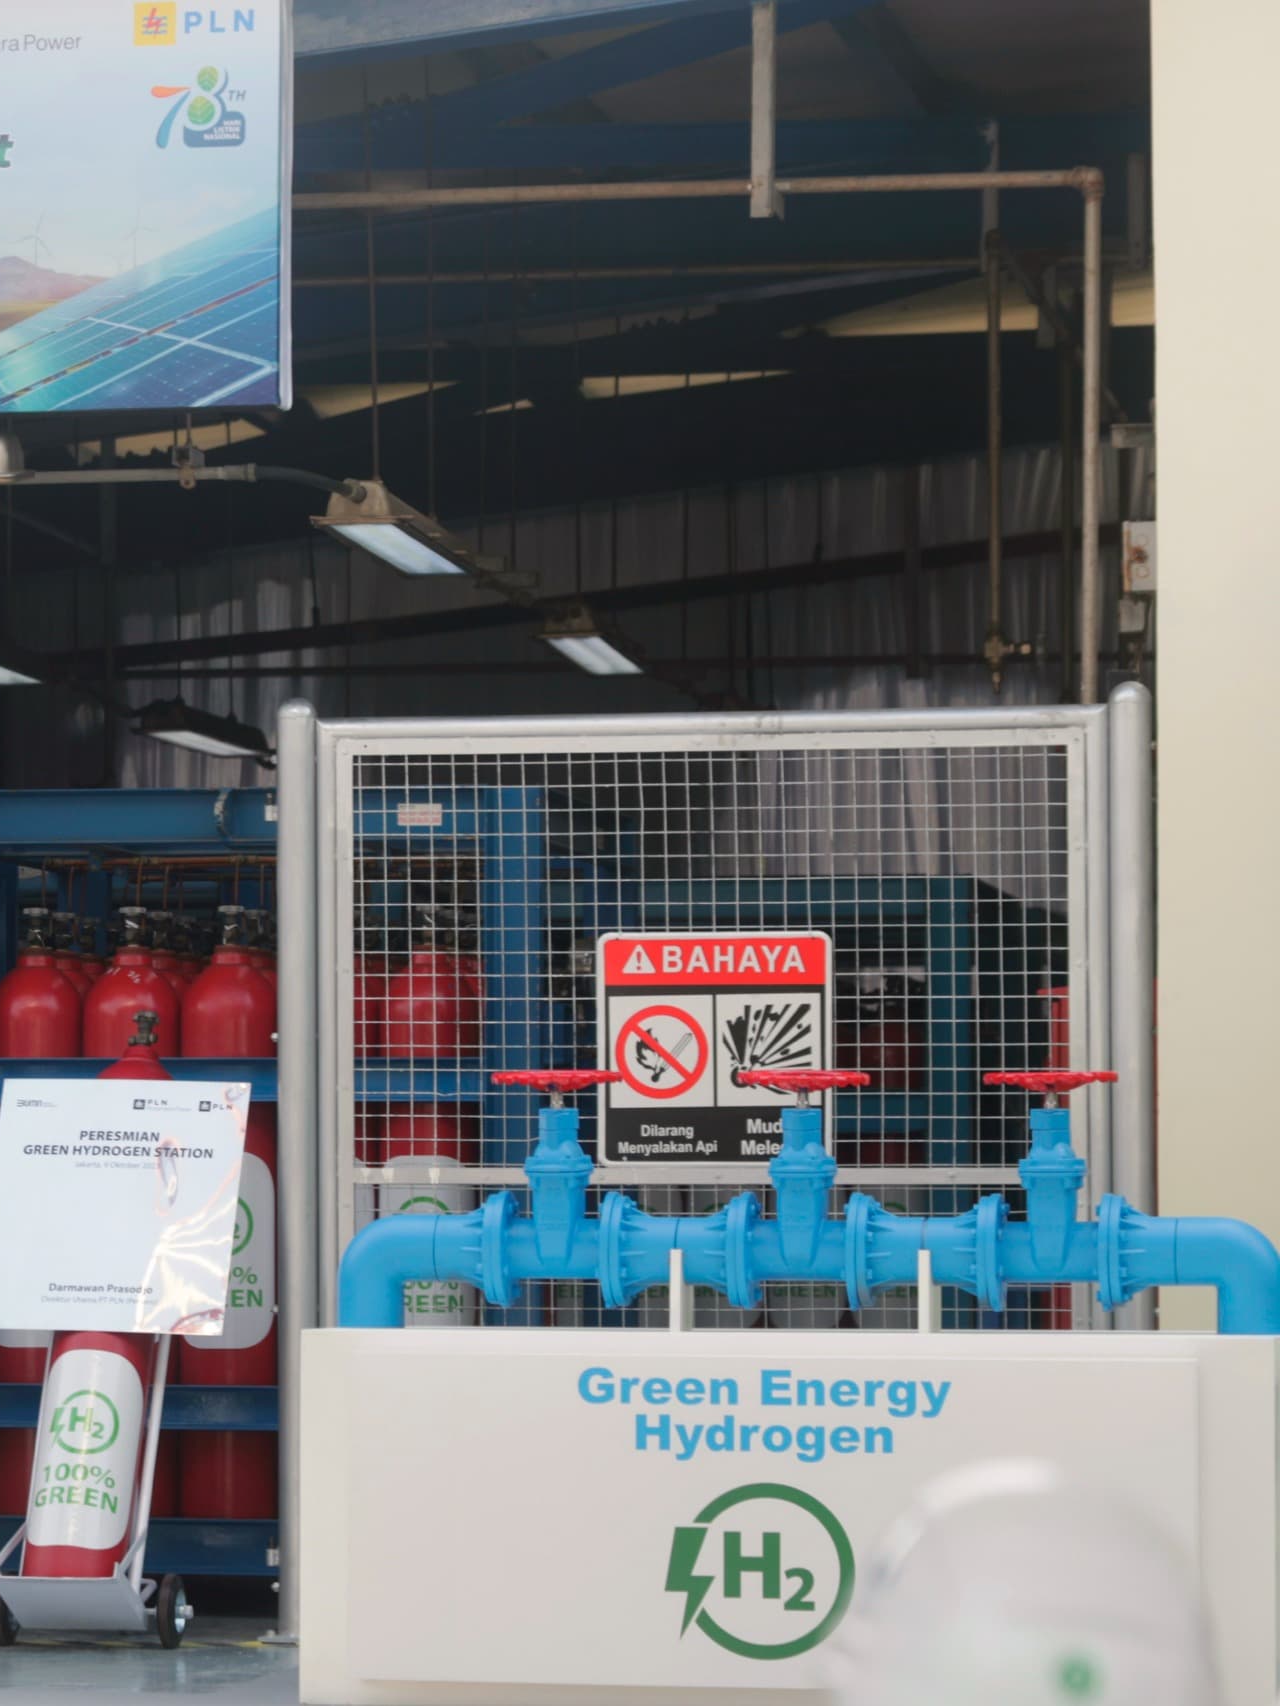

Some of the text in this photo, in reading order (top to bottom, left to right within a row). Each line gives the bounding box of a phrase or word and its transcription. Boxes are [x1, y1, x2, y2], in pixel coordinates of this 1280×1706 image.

[184, 9, 255, 34] PLN
[23, 33, 82, 51] Power
[662, 944, 806, 974] BAHAYA
[147, 1098, 169, 1106] PLN
[641, 1124, 694, 1139] Dilarang
[746, 1117, 783, 1134] Mud
[79, 1130, 161, 1142] PERESMIAN
[23, 1144, 214, 1159] GREEN HYDROGEN STATION
[618, 1140, 718, 1157] Menyalakan Api
[740, 1139, 782, 1155] Mele
[48, 1283, 105, 1293] Darmawan
[578, 1367, 952, 1418] Green Energy
[68, 1405, 105, 1440] H2
[635, 1414, 894, 1463] Hydrogen
[43, 1463, 116, 1489] 100%
[33, 1486, 119, 1514] GREEN
[722, 1530, 816, 1612] H2
